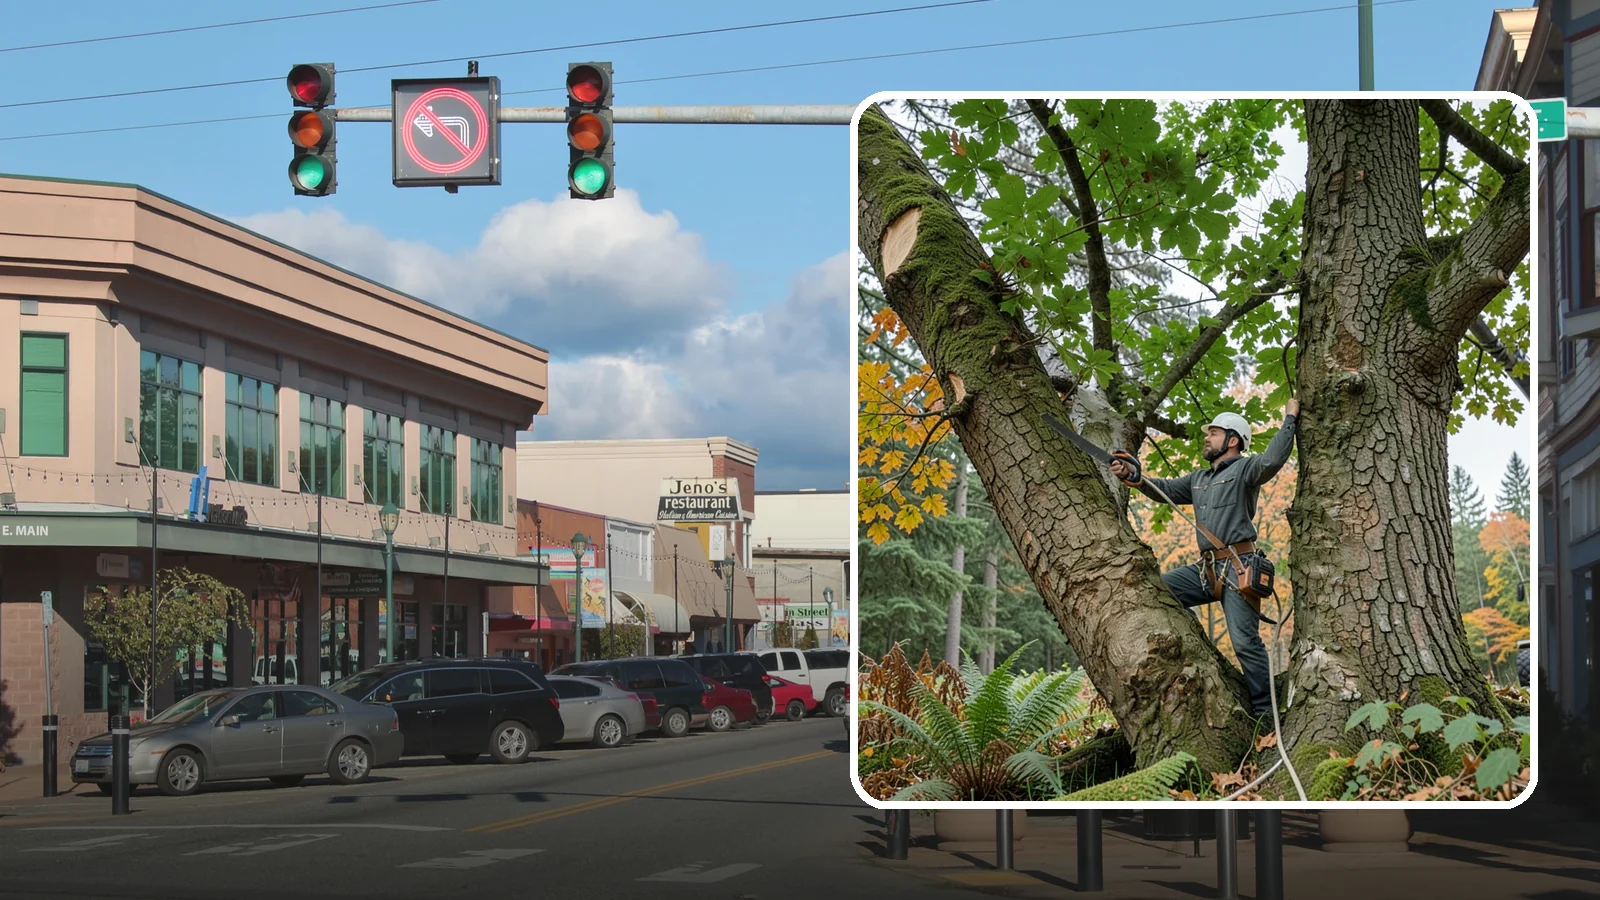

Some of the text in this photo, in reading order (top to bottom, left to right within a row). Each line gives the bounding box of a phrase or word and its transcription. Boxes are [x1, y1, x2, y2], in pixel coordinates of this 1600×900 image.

[669, 480, 727, 495] Jeno's
[665, 496, 731, 509] restaurant
[658, 509, 682, 520] Italian
[686, 509, 714, 519] American
[714, 509, 737, 519] Cuisine
[2, 525, 49, 536] E. MAIN
[797, 607, 829, 617] Street
[791, 619, 824, 627] lass
